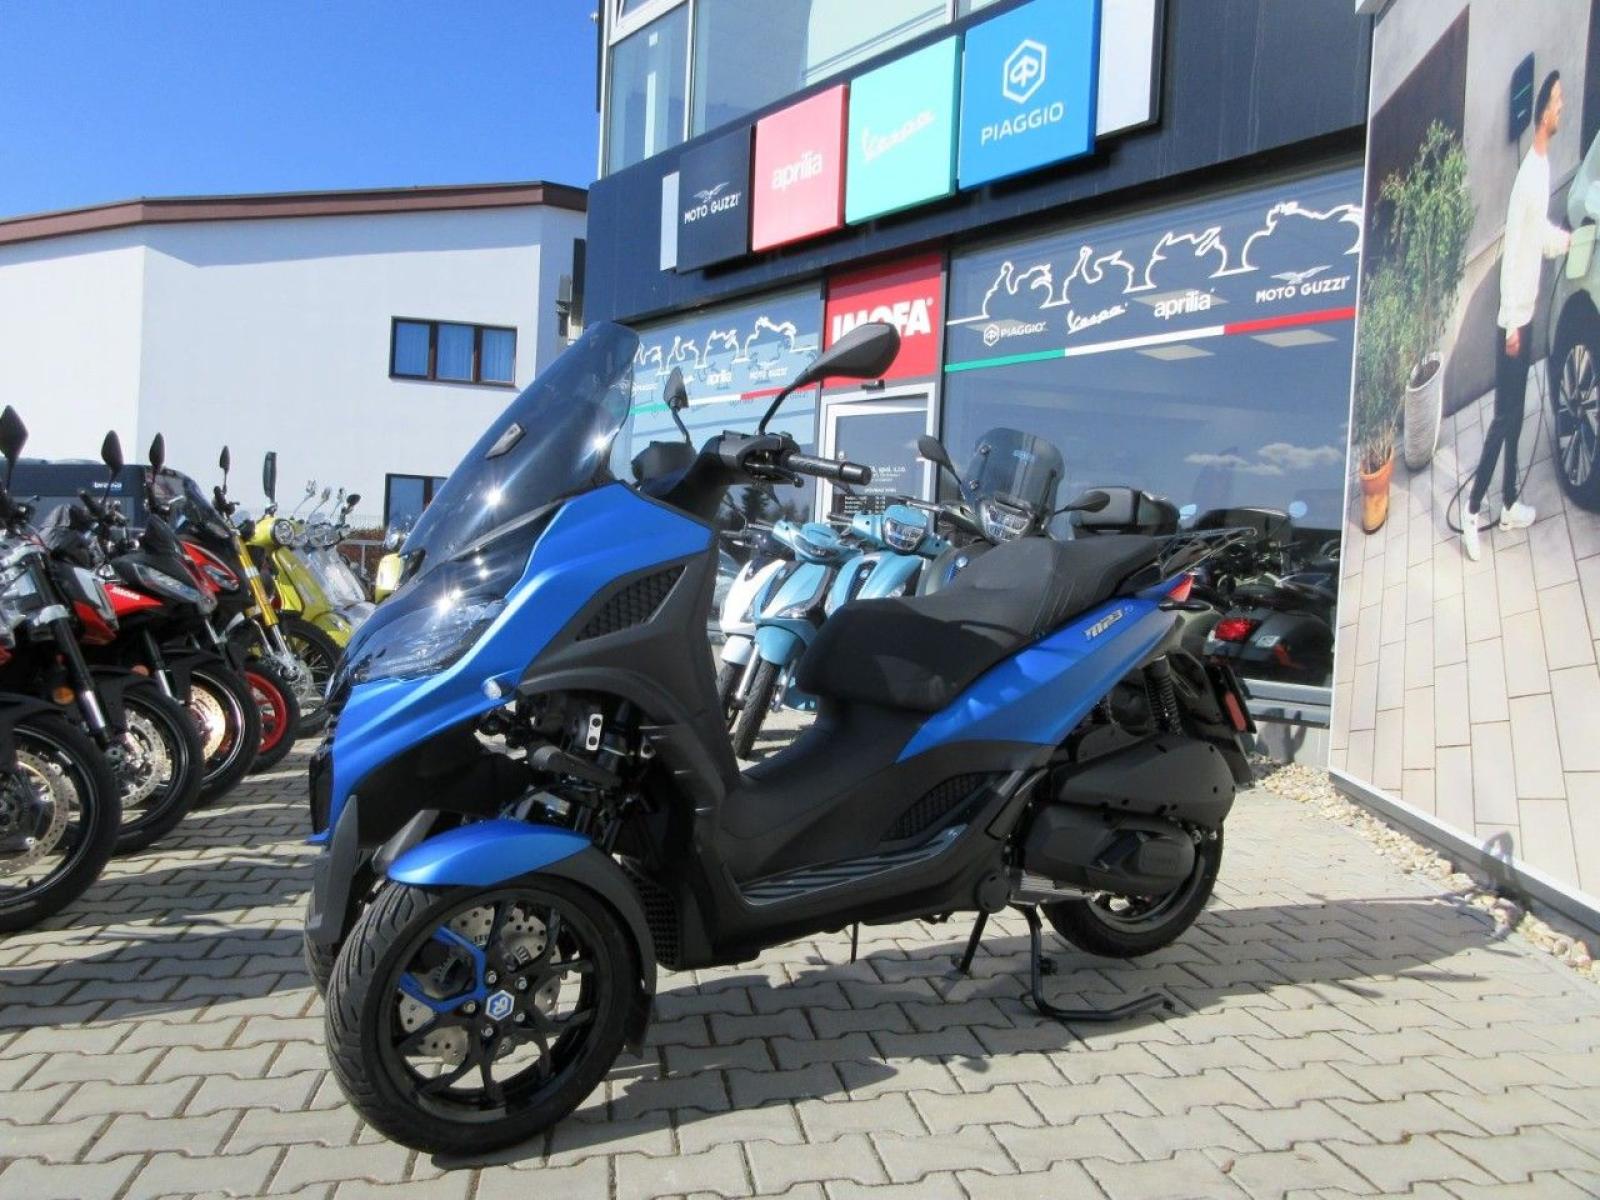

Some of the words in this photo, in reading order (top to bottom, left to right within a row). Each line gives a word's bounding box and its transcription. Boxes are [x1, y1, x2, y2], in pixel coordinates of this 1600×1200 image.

[861, 110, 935, 162] Vespa
[981, 101, 1065, 146] PIAGGIO
[770, 149, 824, 191] aprilia
[684, 202, 708, 224] MOTO
[710, 193, 739, 213] GUZZI
[1153, 290, 1212, 320] aprilia
[1256, 285, 1296, 304] MOTO
[1300, 278, 1348, 297] GUZZI
[1000, 322, 1045, 338] PIAGGIO
[1067, 304, 1127, 334] Vespa
